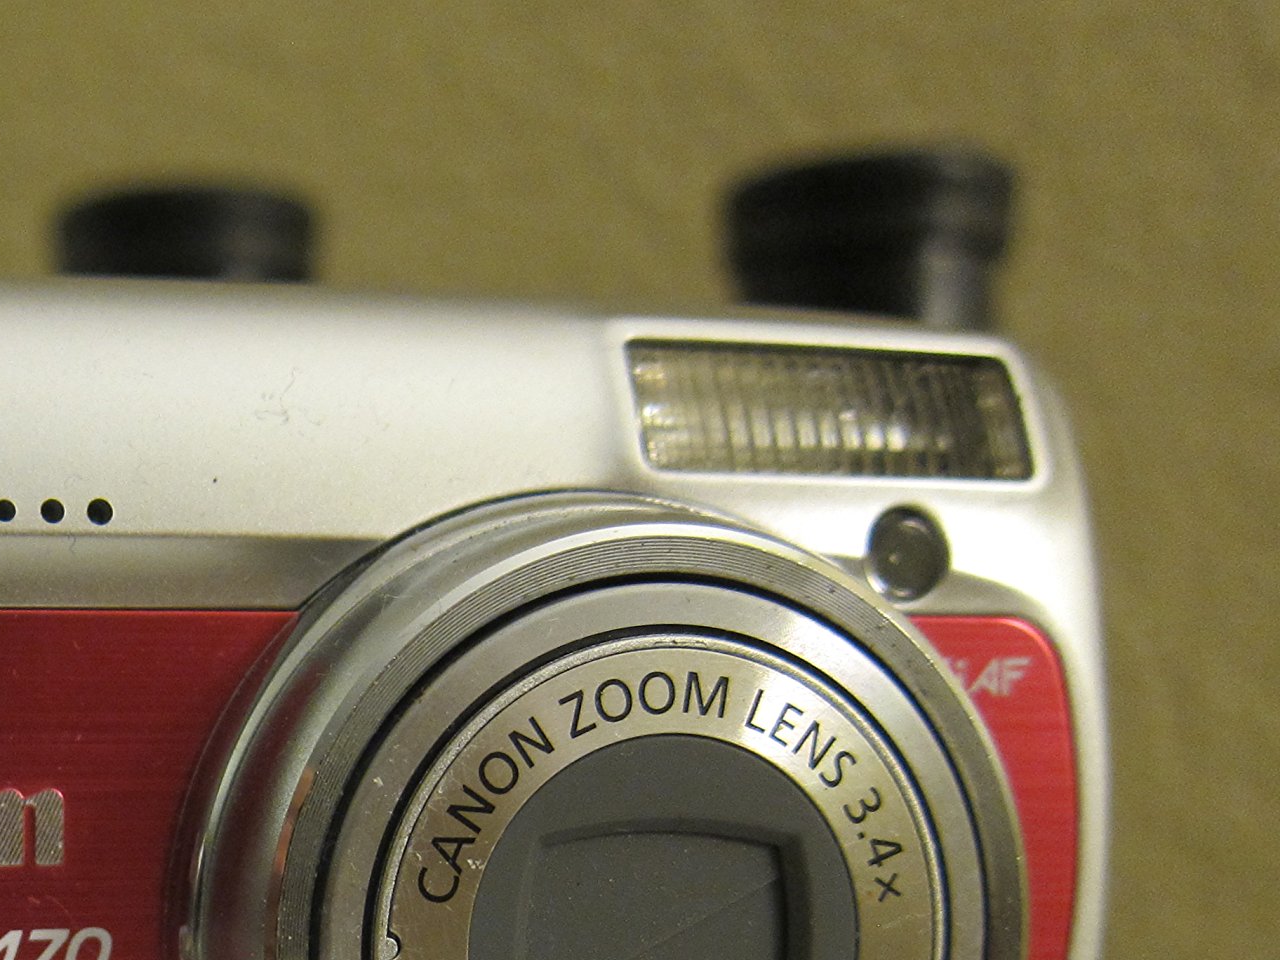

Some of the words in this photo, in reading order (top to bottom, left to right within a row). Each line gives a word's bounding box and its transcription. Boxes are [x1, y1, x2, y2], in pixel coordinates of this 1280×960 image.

[417, 716, 555, 903] CANON
[558, 671, 730, 739] ZOOM
[743, 689, 858, 789] LENS
